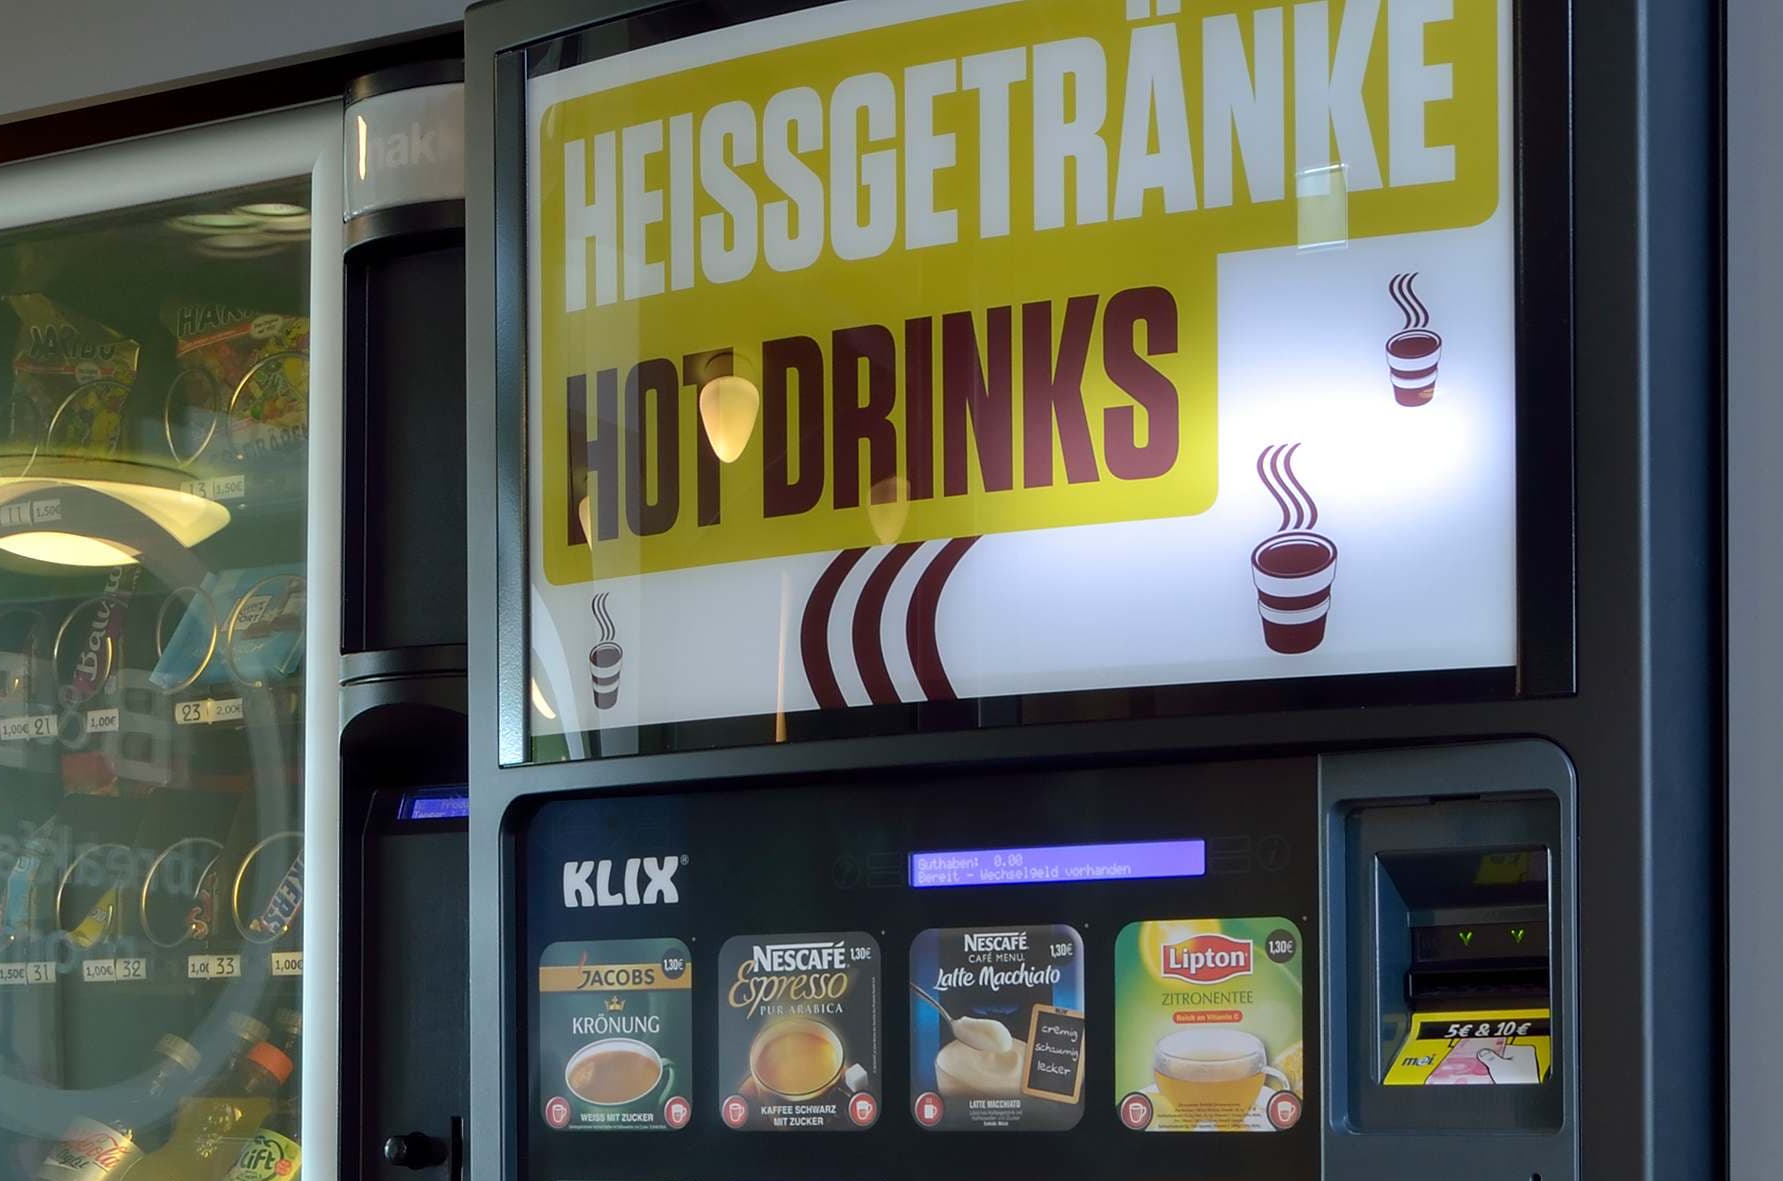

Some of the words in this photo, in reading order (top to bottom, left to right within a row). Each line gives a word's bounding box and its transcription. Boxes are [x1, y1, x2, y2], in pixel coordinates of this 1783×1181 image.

[563, 0, 1456, 314] HEISSGETRÄNKE
[566, 348, 733, 546] HOT
[762, 285, 1181, 519] DRINKS
[182, 703, 202, 722] 23
[34, 718, 52, 735] 21
[563, 855, 680, 908] KLIX
[918, 871, 960, 884] Bereit
[1065, 863, 1132, 877] vorhanden
[964, 931, 1028, 953] NESCAFÉ
[1049, 943, 1074, 958] 1,30€
[752, 941, 847, 972] NESCAFÉ
[968, 952, 993, 964] CAFÉ
[995, 953, 1025, 963] MENU
[1168, 945, 1246, 972] Lipton
[1268, 940, 1294, 954] 1,30€
[34, 964, 50, 981] 31
[123, 960, 142, 978] 32
[216, 957, 235, 975] 33
[577, 967, 656, 990] JACOBS
[934, 967, 976, 991] Latte
[978, 963, 1061, 991] Macchiato
[728, 959, 848, 1020] Espresso
[1161, 991, 1254, 1007] ZITRONENTEE
[787, 1003, 844, 1015] ARABICA
[572, 1014, 661, 1036] KRÖNUNG
[1041, 1024, 1079, 1041] cremig
[1037, 1061, 1071, 1076] lecker
[580, 1113, 606, 1123] WEISS
[607, 1113, 620, 1123] MIT
[621, 1112, 654, 1123] ZUCKER
[761, 1105, 793, 1115] KAFFEE
[794, 1104, 837, 1115] SCHWARZ
[774, 1117, 788, 1126] MIT
[789, 1116, 824, 1126] ZUCKER
